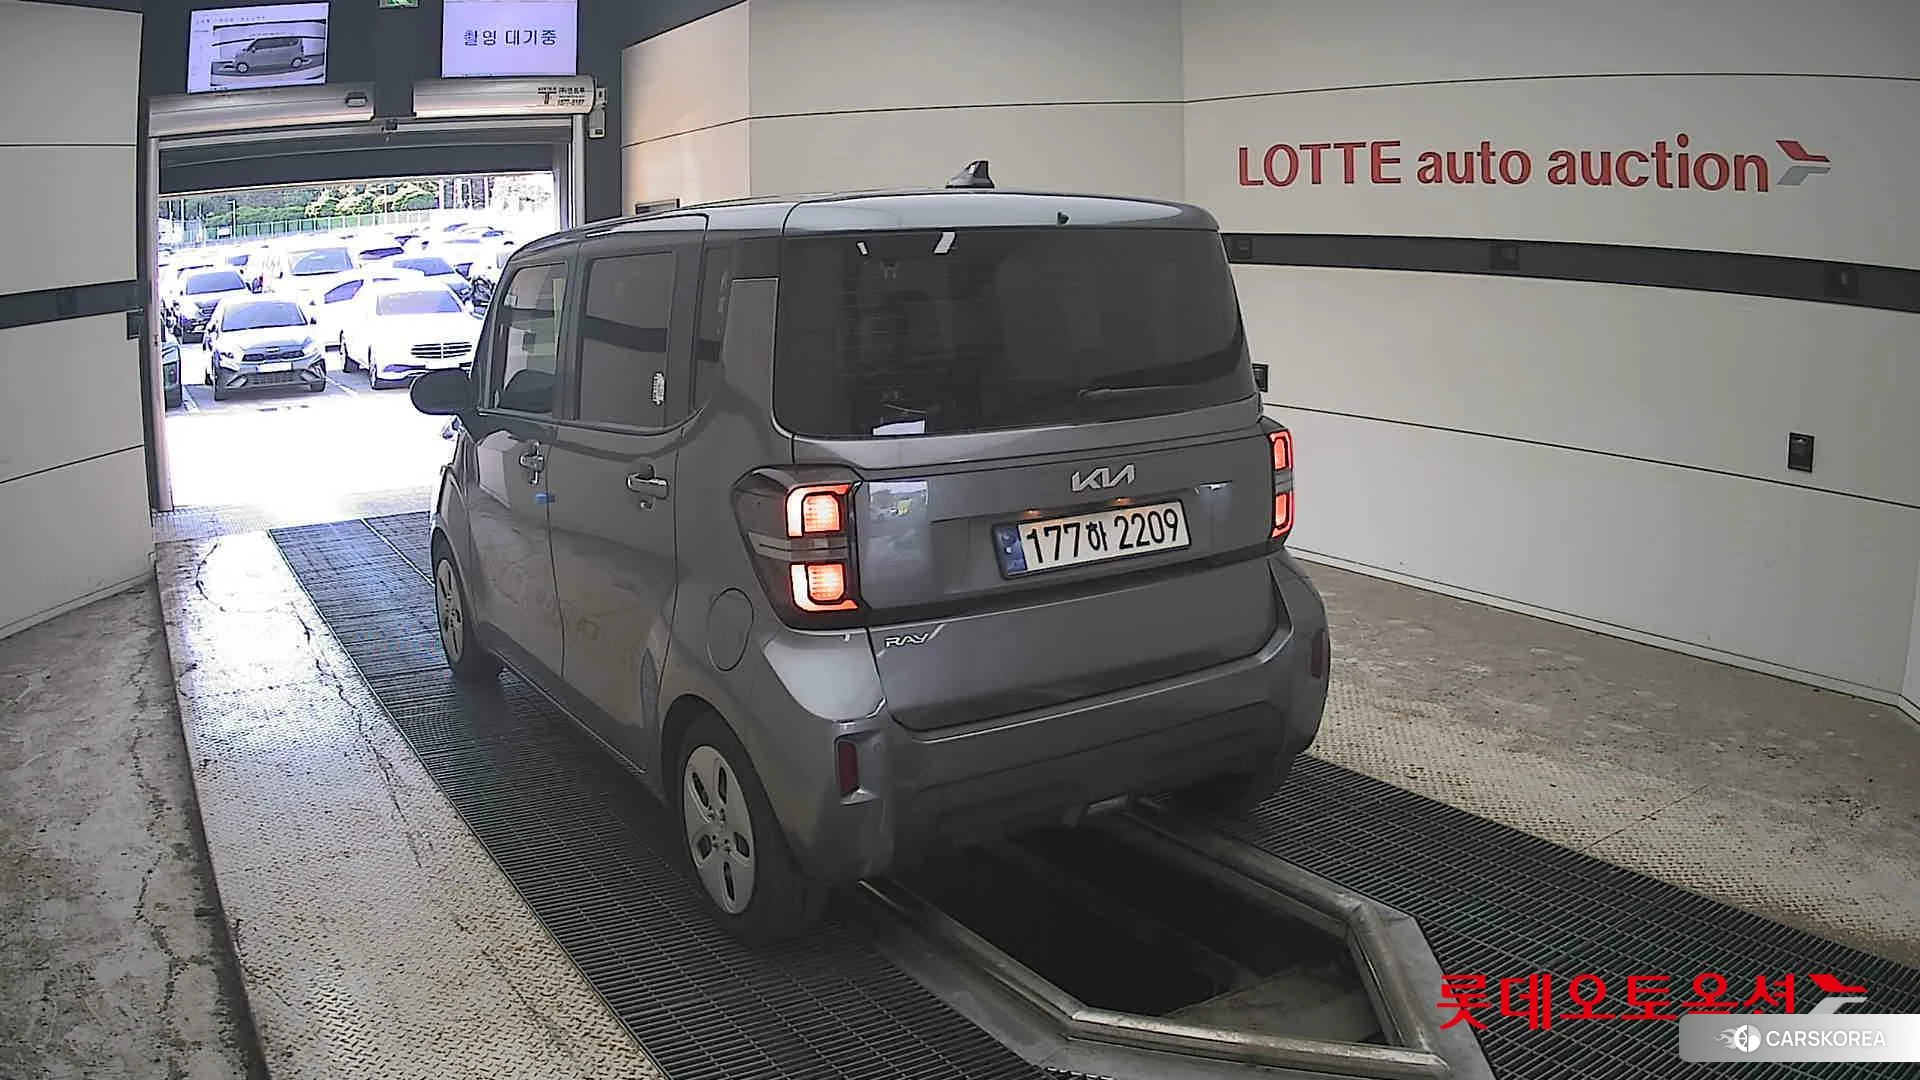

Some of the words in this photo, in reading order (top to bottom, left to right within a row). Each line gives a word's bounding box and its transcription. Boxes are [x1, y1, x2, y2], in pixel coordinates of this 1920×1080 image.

[505, 29, 557, 46] 대기중
[1238, 139, 1401, 187] LOTTE
[1416, 140, 1532, 187] auto
[1547, 133, 1769, 193] auction
[1071, 464, 1136, 492] KIA
[1026, 521, 1108, 563] 177하
[1114, 508, 1179, 550] 2209
[884, 630, 934, 648] RAY
